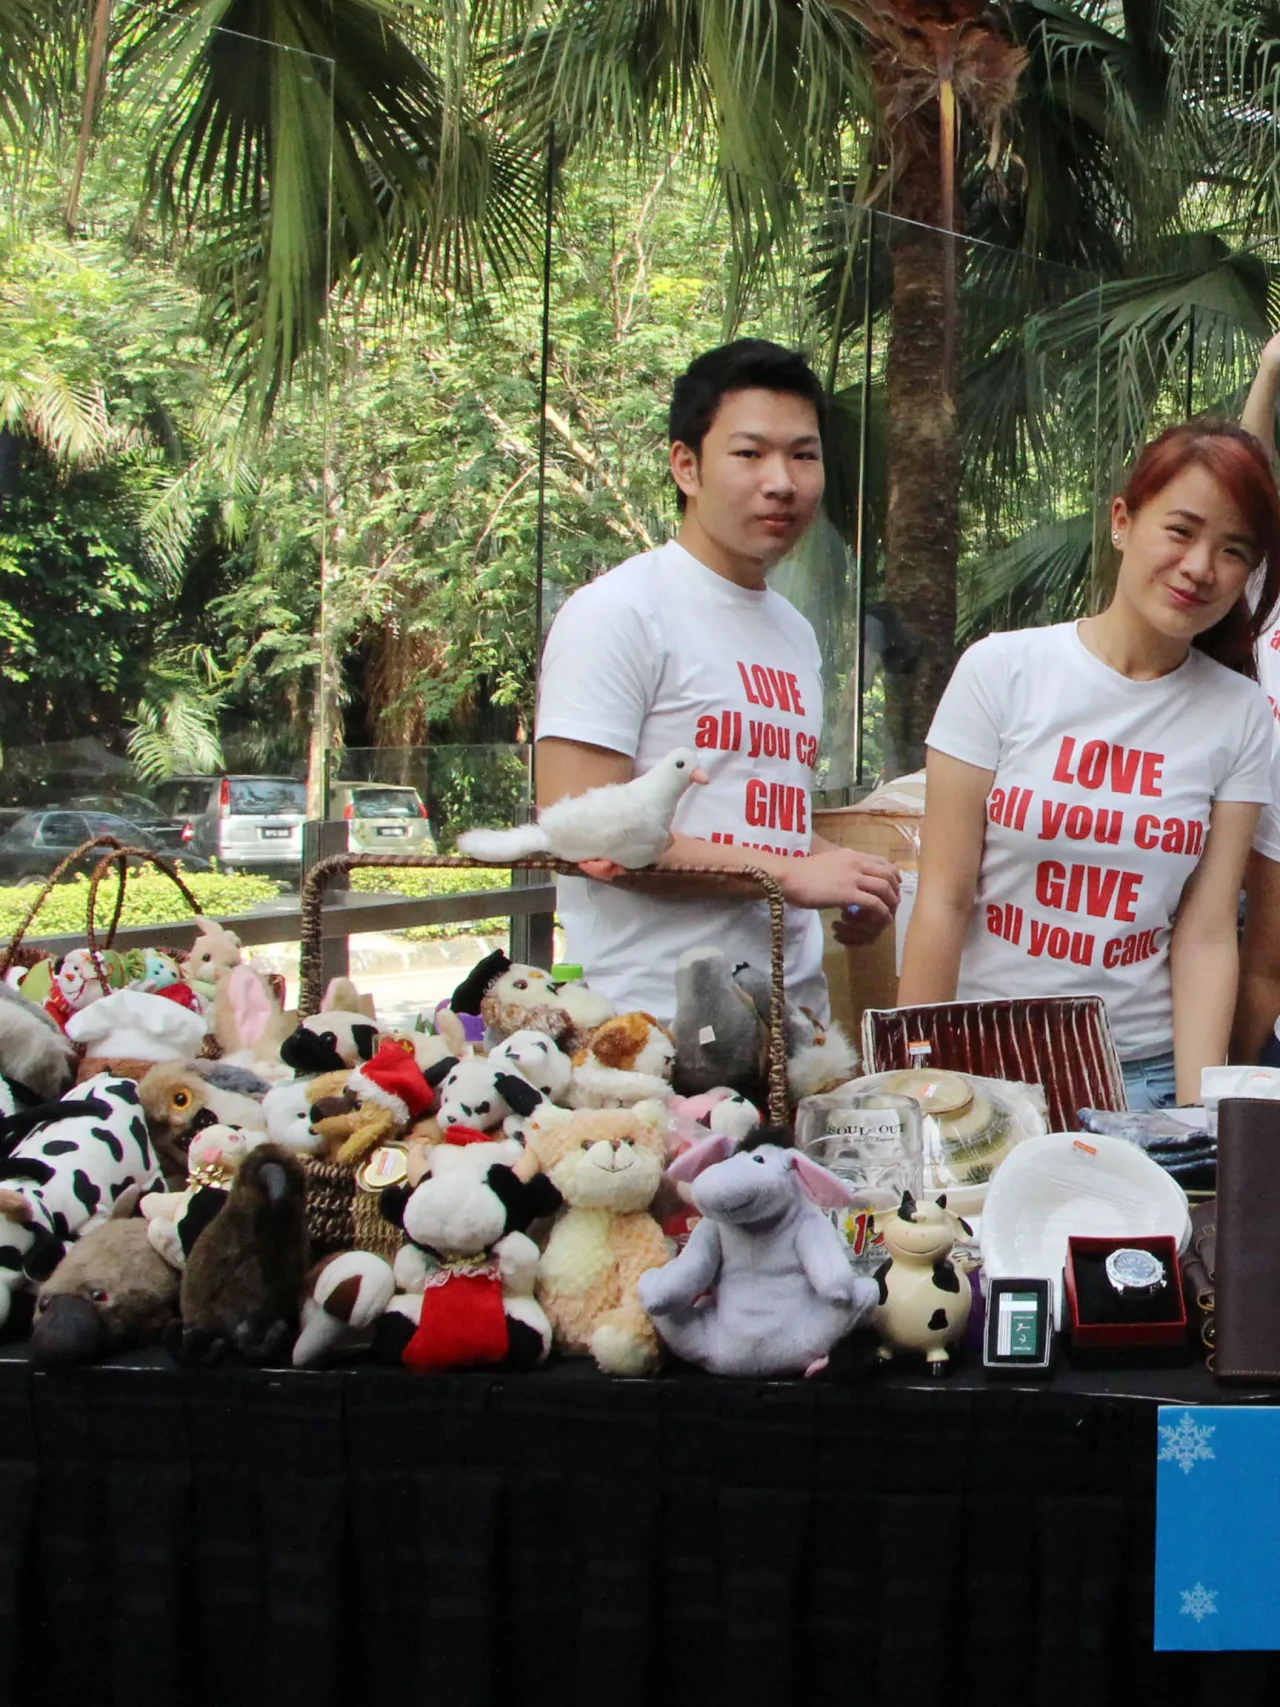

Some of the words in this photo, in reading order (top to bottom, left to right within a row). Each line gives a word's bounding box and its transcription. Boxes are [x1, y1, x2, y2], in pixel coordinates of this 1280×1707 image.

[736, 660, 806, 717] LOVE
[695, 710, 742, 752] all
[748, 719, 791, 760] you
[1052, 735, 1166, 798] LOVE
[744, 778, 807, 835] GIVE
[988, 786, 1035, 832] all
[1037, 799, 1124, 846] you
[1035, 859, 1145, 924] GIVE
[986, 902, 1025, 947] all
[1026, 919, 1096, 967] you
[878, 1122, 906, 1136] OUT
